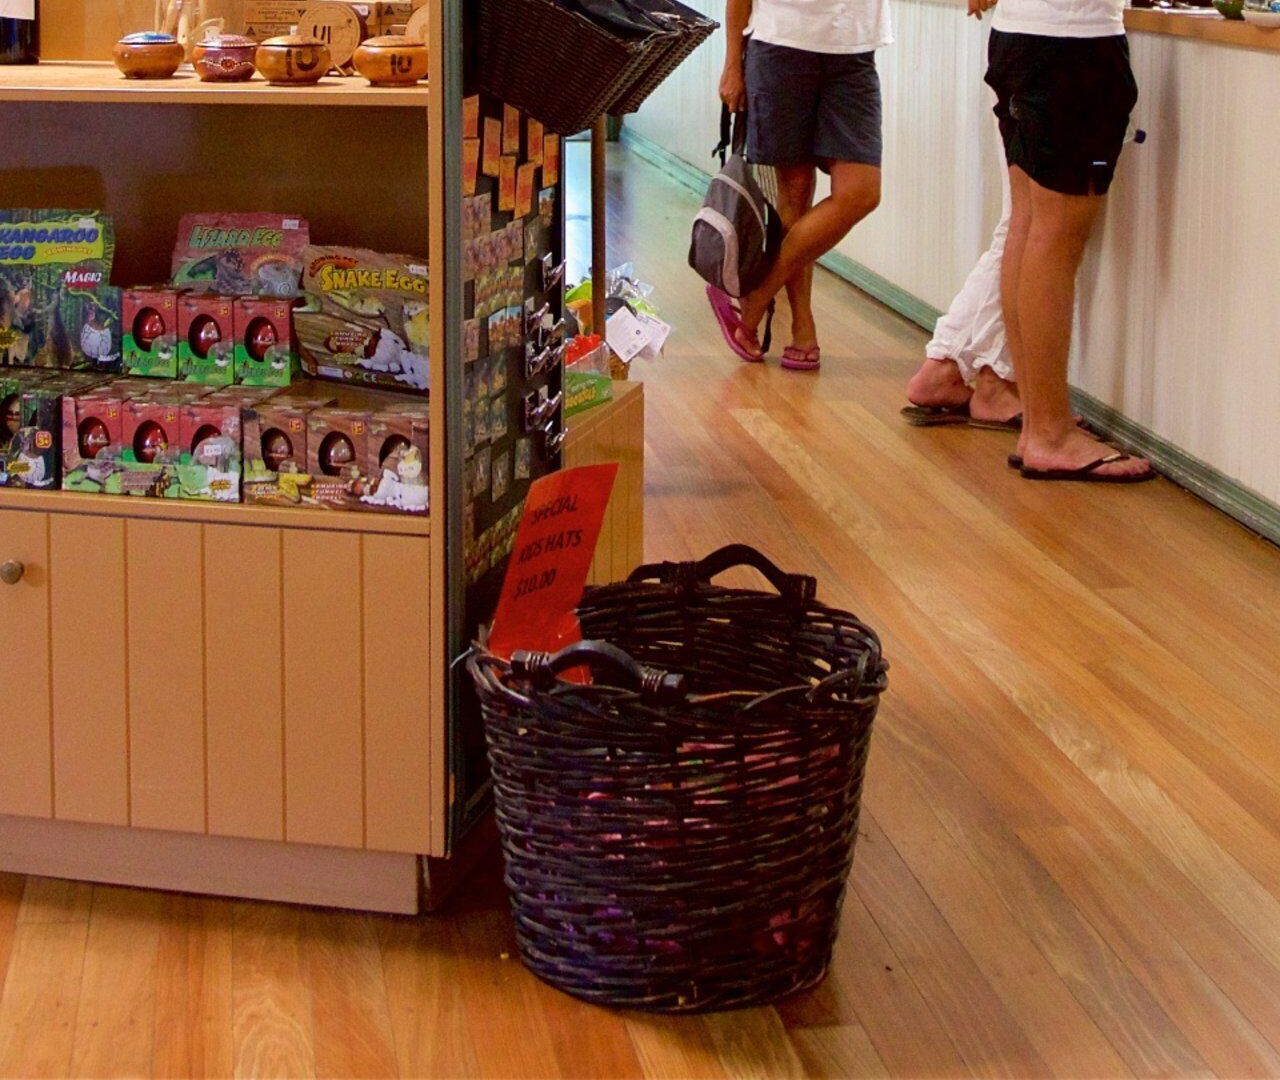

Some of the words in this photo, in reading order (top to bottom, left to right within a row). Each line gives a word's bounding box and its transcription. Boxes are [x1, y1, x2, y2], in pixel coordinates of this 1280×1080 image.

[188, 224, 250, 249] LIZARD
[251, 226, 284, 247] EGG
[320, 264, 382, 292] SNAKE
[383, 269, 427, 294] EGG
[530, 493, 578, 526] SPECIAL
[544, 529, 583, 553] HATS
